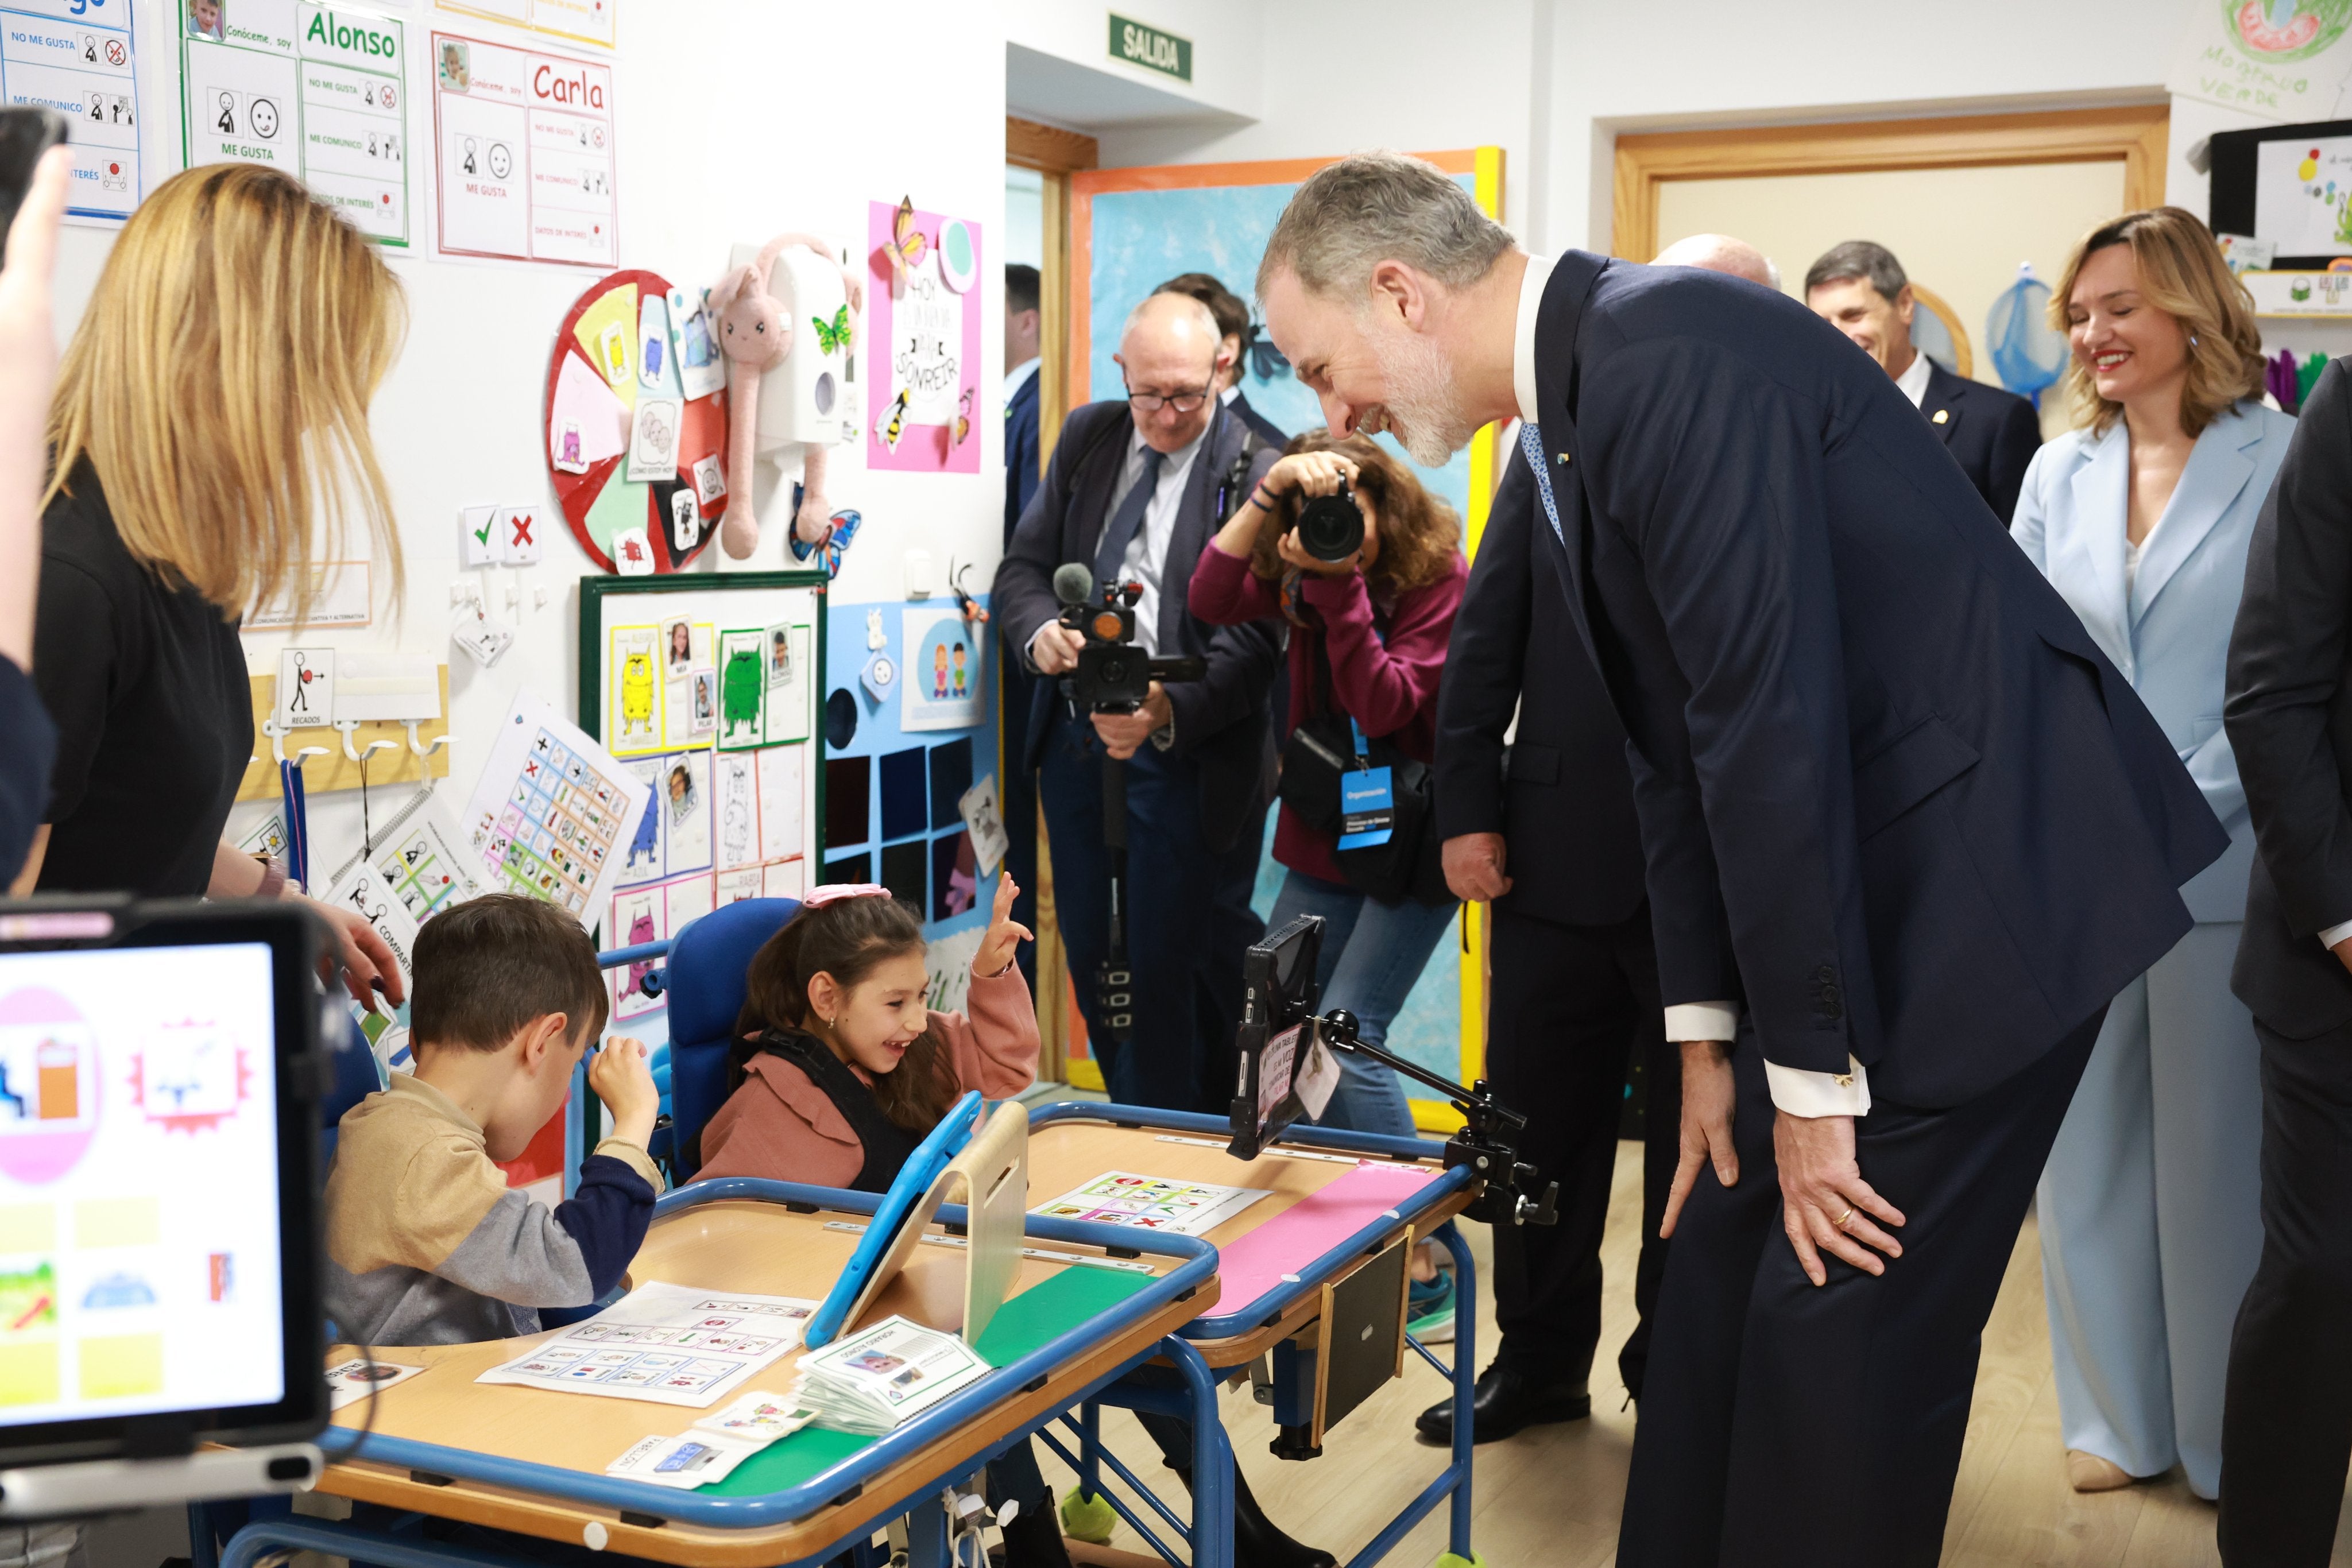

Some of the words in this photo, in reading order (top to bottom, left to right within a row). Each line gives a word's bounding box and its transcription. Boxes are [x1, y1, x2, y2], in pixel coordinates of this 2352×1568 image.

[11, 32, 26, 42] NO
[29, 34, 43, 45] ME
[45, 37, 75, 50] GUSTA
[227, 25, 272, 45] Conóceme,
[277, 38, 292, 50] soy
[307, 12, 396, 57] Alonso
[1123, 24, 1179, 72] SALIDA
[309, 79, 320, 87] NO
[323, 80, 334, 90] ME
[335, 83, 358, 94] GUSTA
[535, 65, 603, 109] Carla
[14, 95, 28, 106] ME
[31, 98, 83, 113] COMUNICO
[310, 134, 320, 143] ME
[323, 136, 362, 149] COMUNICO
[222, 142, 238, 157] ME
[240, 145, 274, 161] GUSTA
[68, 169, 99, 180] NTERÉS
[466, 183, 478, 194] ME
[481, 185, 507, 198] GUSTA
[347, 198, 373, 209] INTERÉS
[291, 715, 320, 725] RECADOS
[380, 926, 413, 980] COMPARTI
